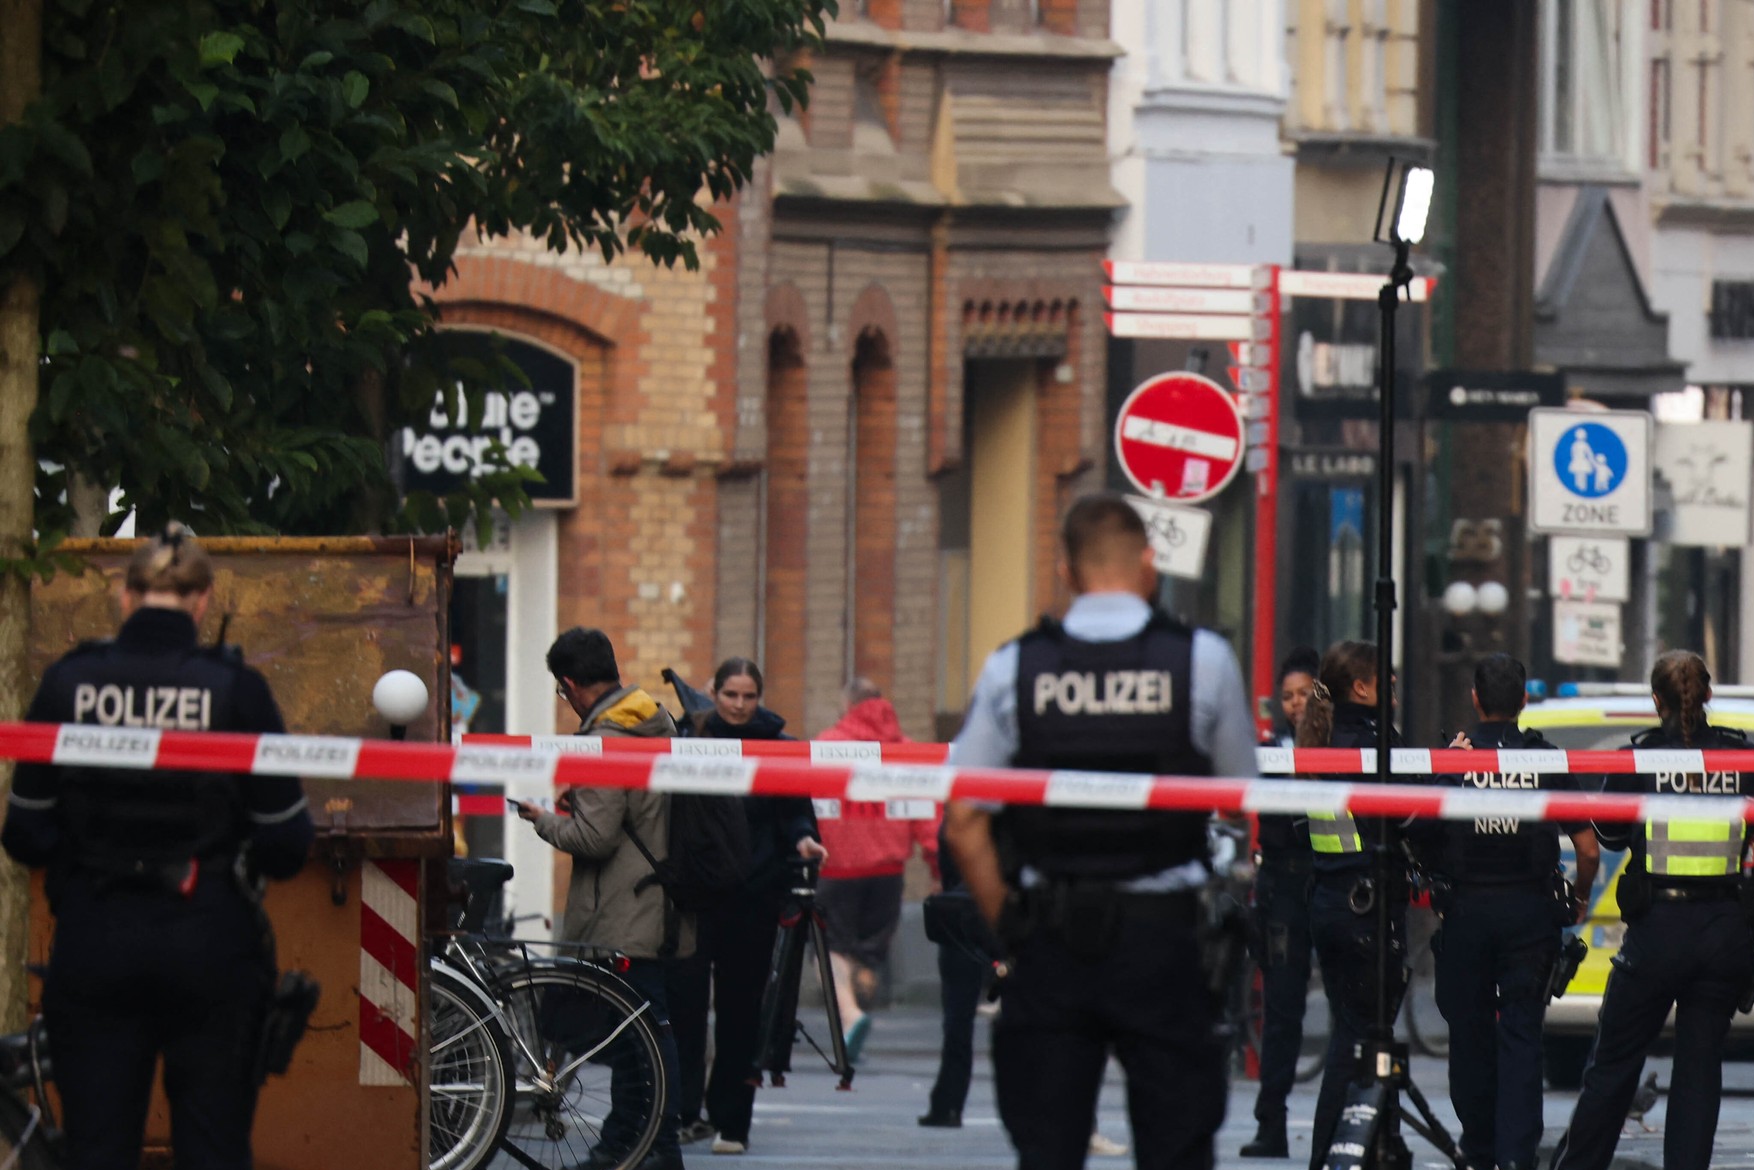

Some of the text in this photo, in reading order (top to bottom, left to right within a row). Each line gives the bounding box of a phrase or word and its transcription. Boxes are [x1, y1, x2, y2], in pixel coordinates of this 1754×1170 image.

[1562, 503, 1620, 525] ZONE
[1034, 671, 1173, 716] POLIZEI
[74, 683, 212, 730] POLIZEI
[1656, 771, 1740, 793] POLIZEI
[1474, 816, 1520, 835] NRW
